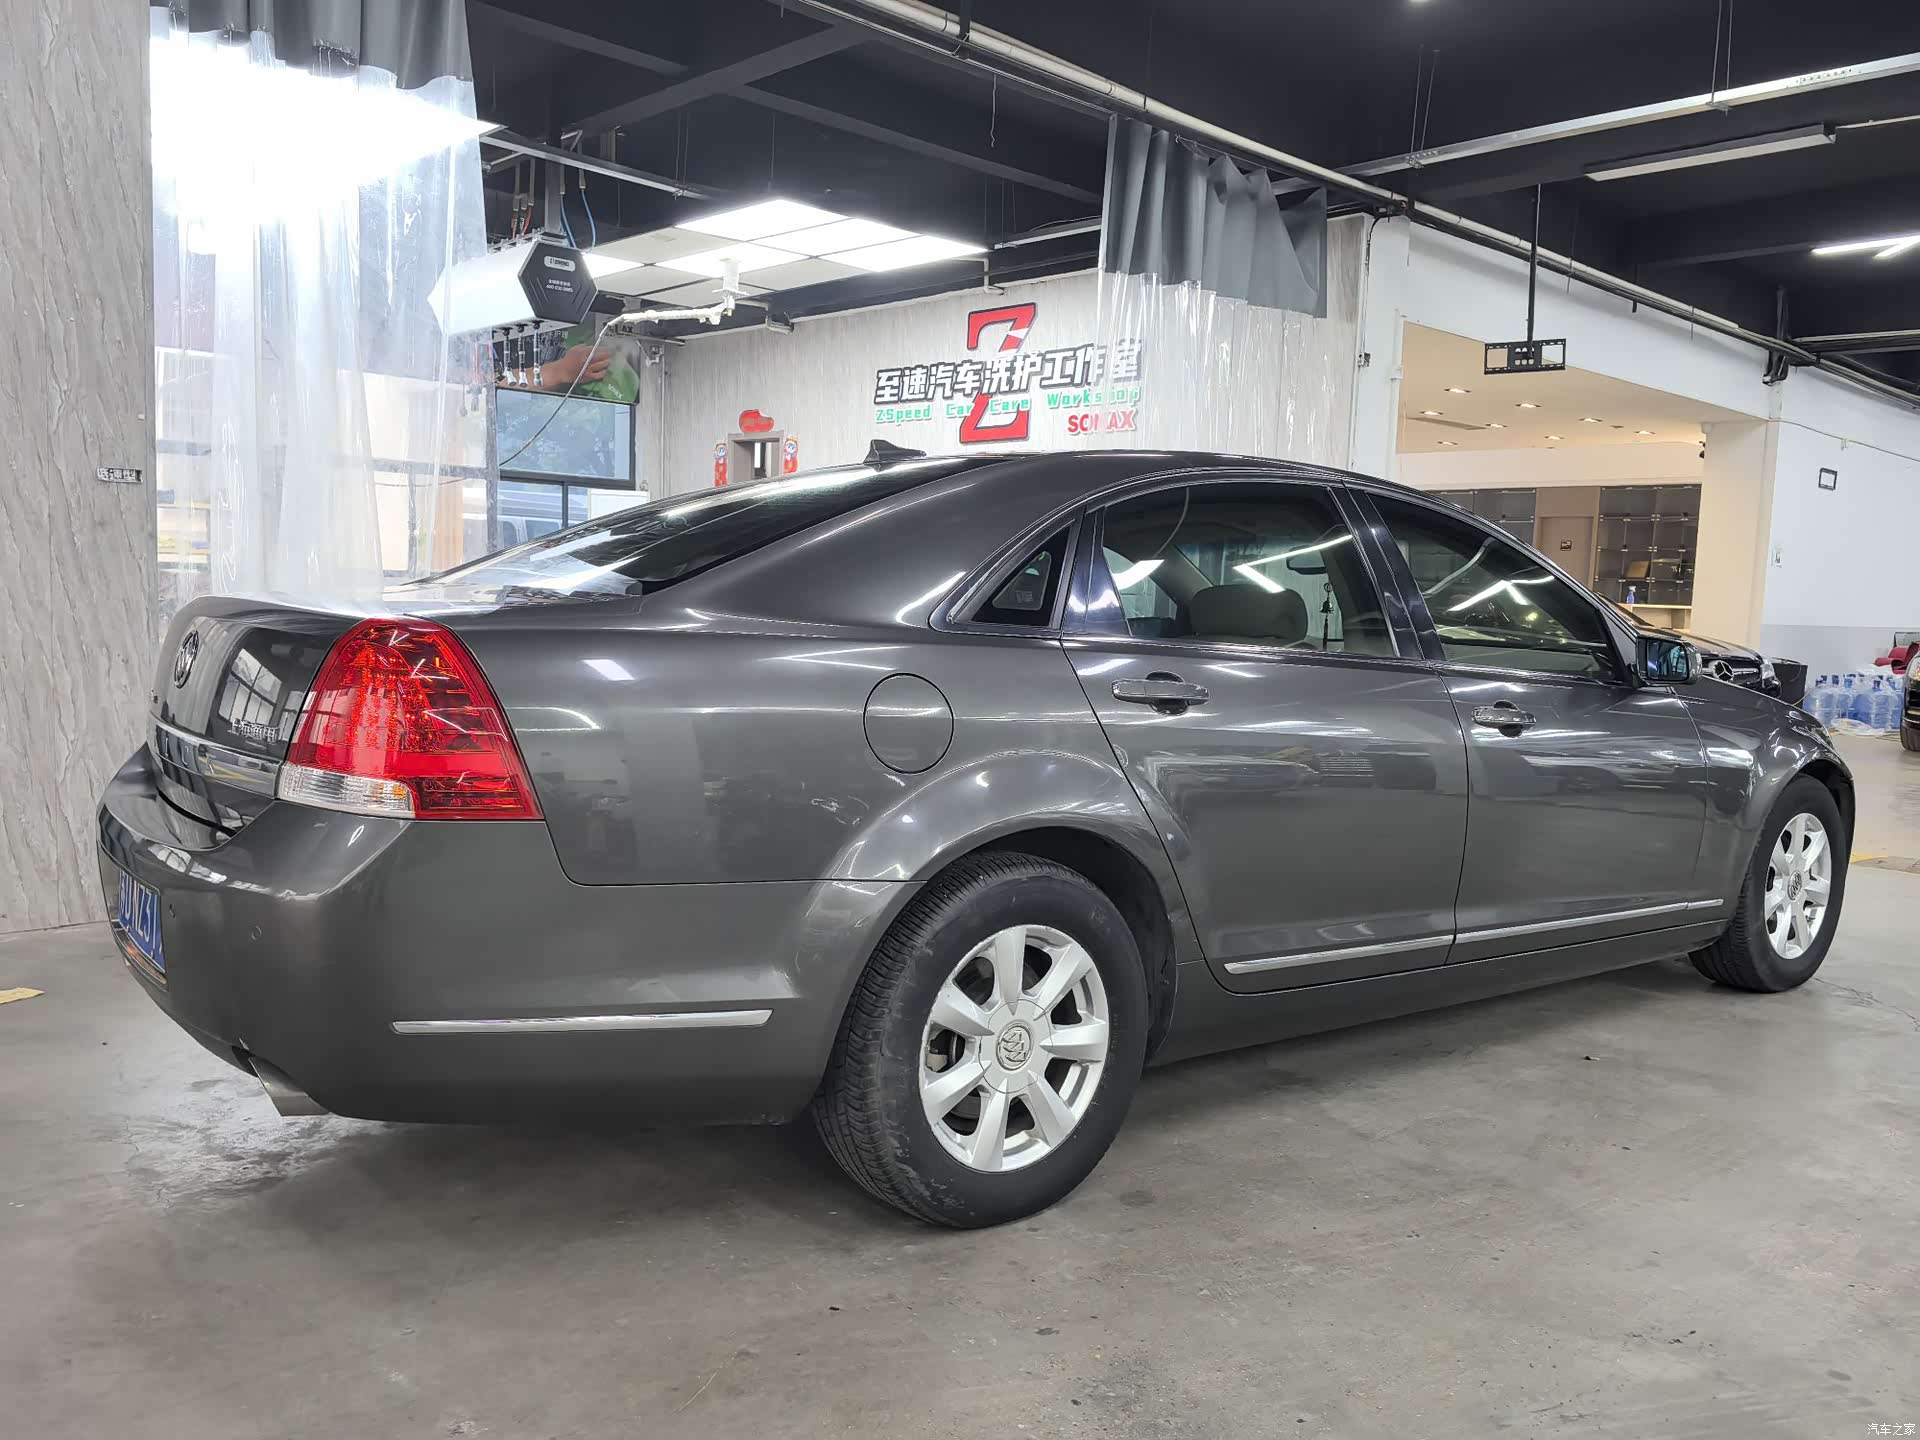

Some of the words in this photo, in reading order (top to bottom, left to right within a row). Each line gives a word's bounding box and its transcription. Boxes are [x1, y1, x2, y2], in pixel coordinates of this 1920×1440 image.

[875, 405, 932, 426] ZSpeed
[945, 401, 974, 419] Car
[988, 397, 1031, 415] Care
